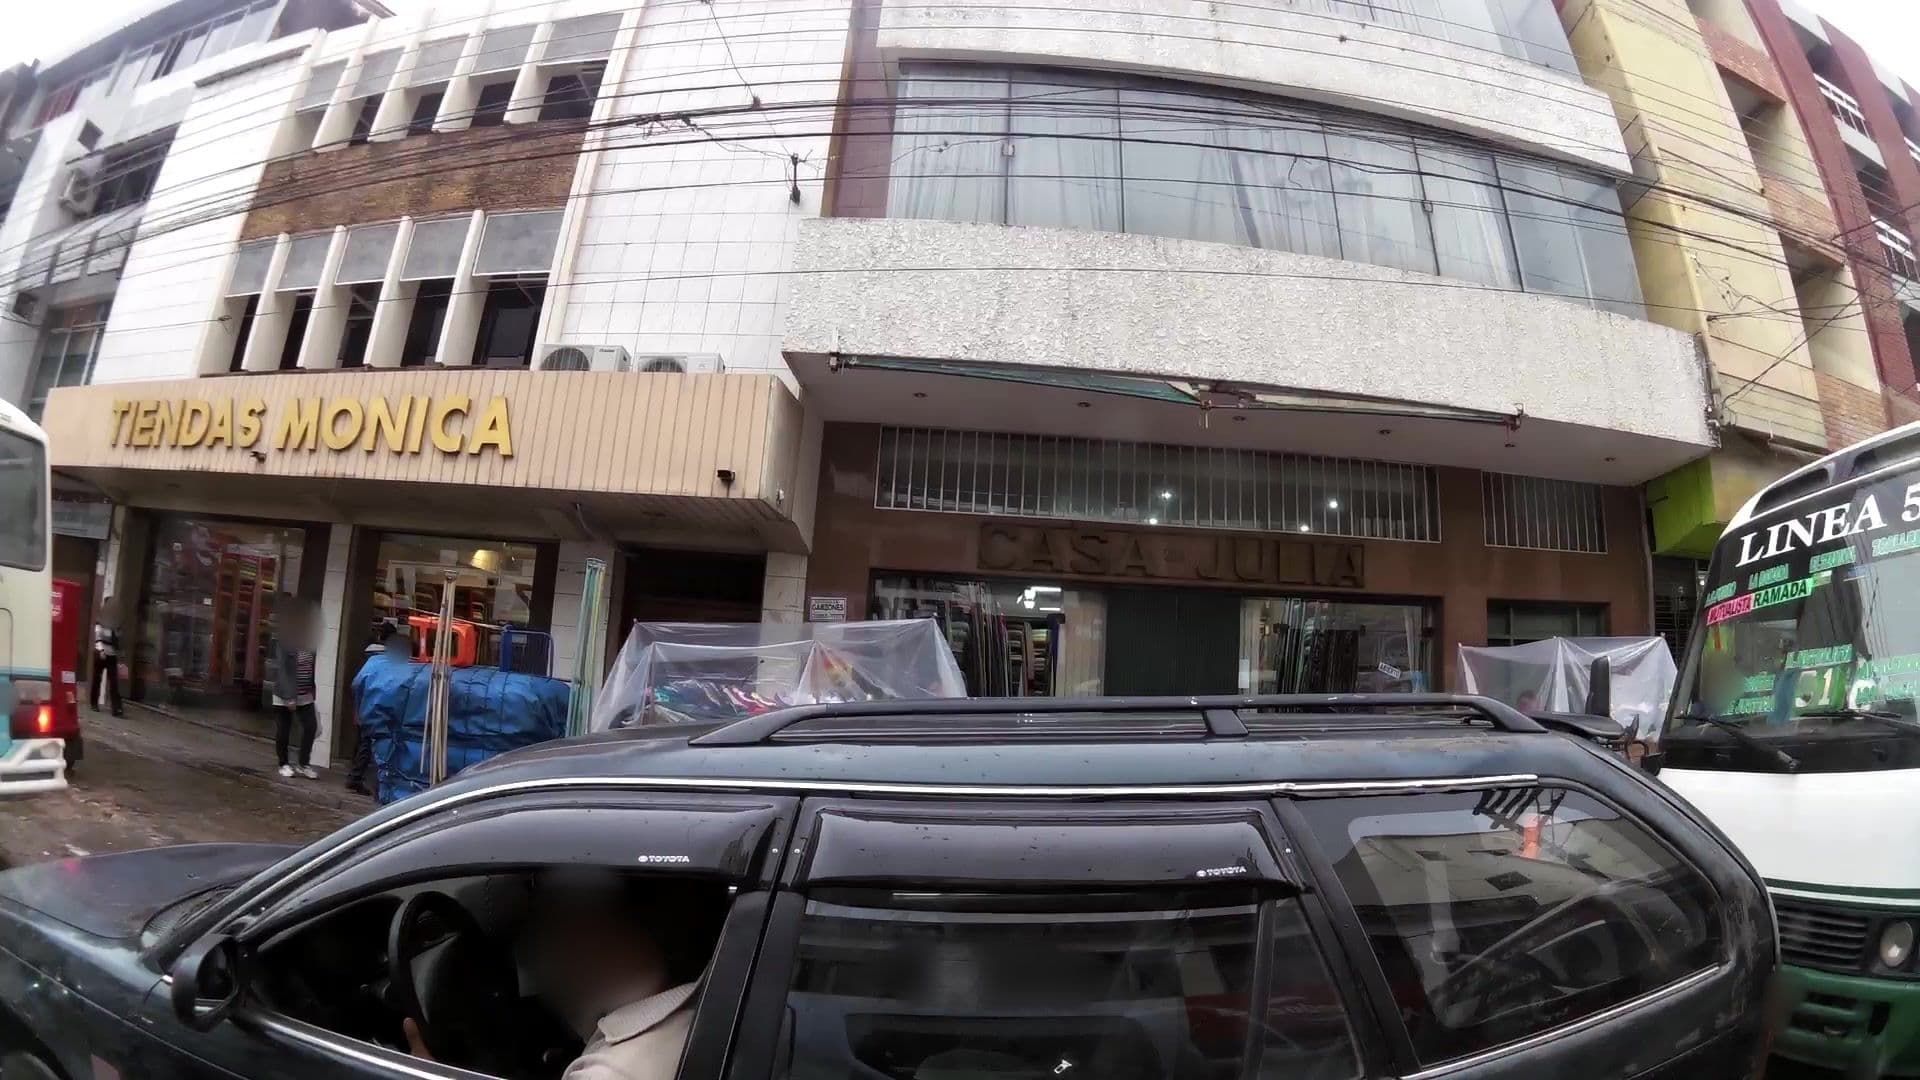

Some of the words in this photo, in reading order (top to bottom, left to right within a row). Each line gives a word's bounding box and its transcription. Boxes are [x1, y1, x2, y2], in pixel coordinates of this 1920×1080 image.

[111, 396, 267, 449] TIENDAS
[275, 394, 513, 458] MONICA
[1735, 494, 1887, 567] LINEA
[978, 522, 1155, 577] CASA
[1195, 534, 1366, 588] JULIA
[1752, 579, 1808, 607] RAMADA
[649, 855, 690, 863] TOYOTA
[1206, 866, 1247, 876] TOYOTA
